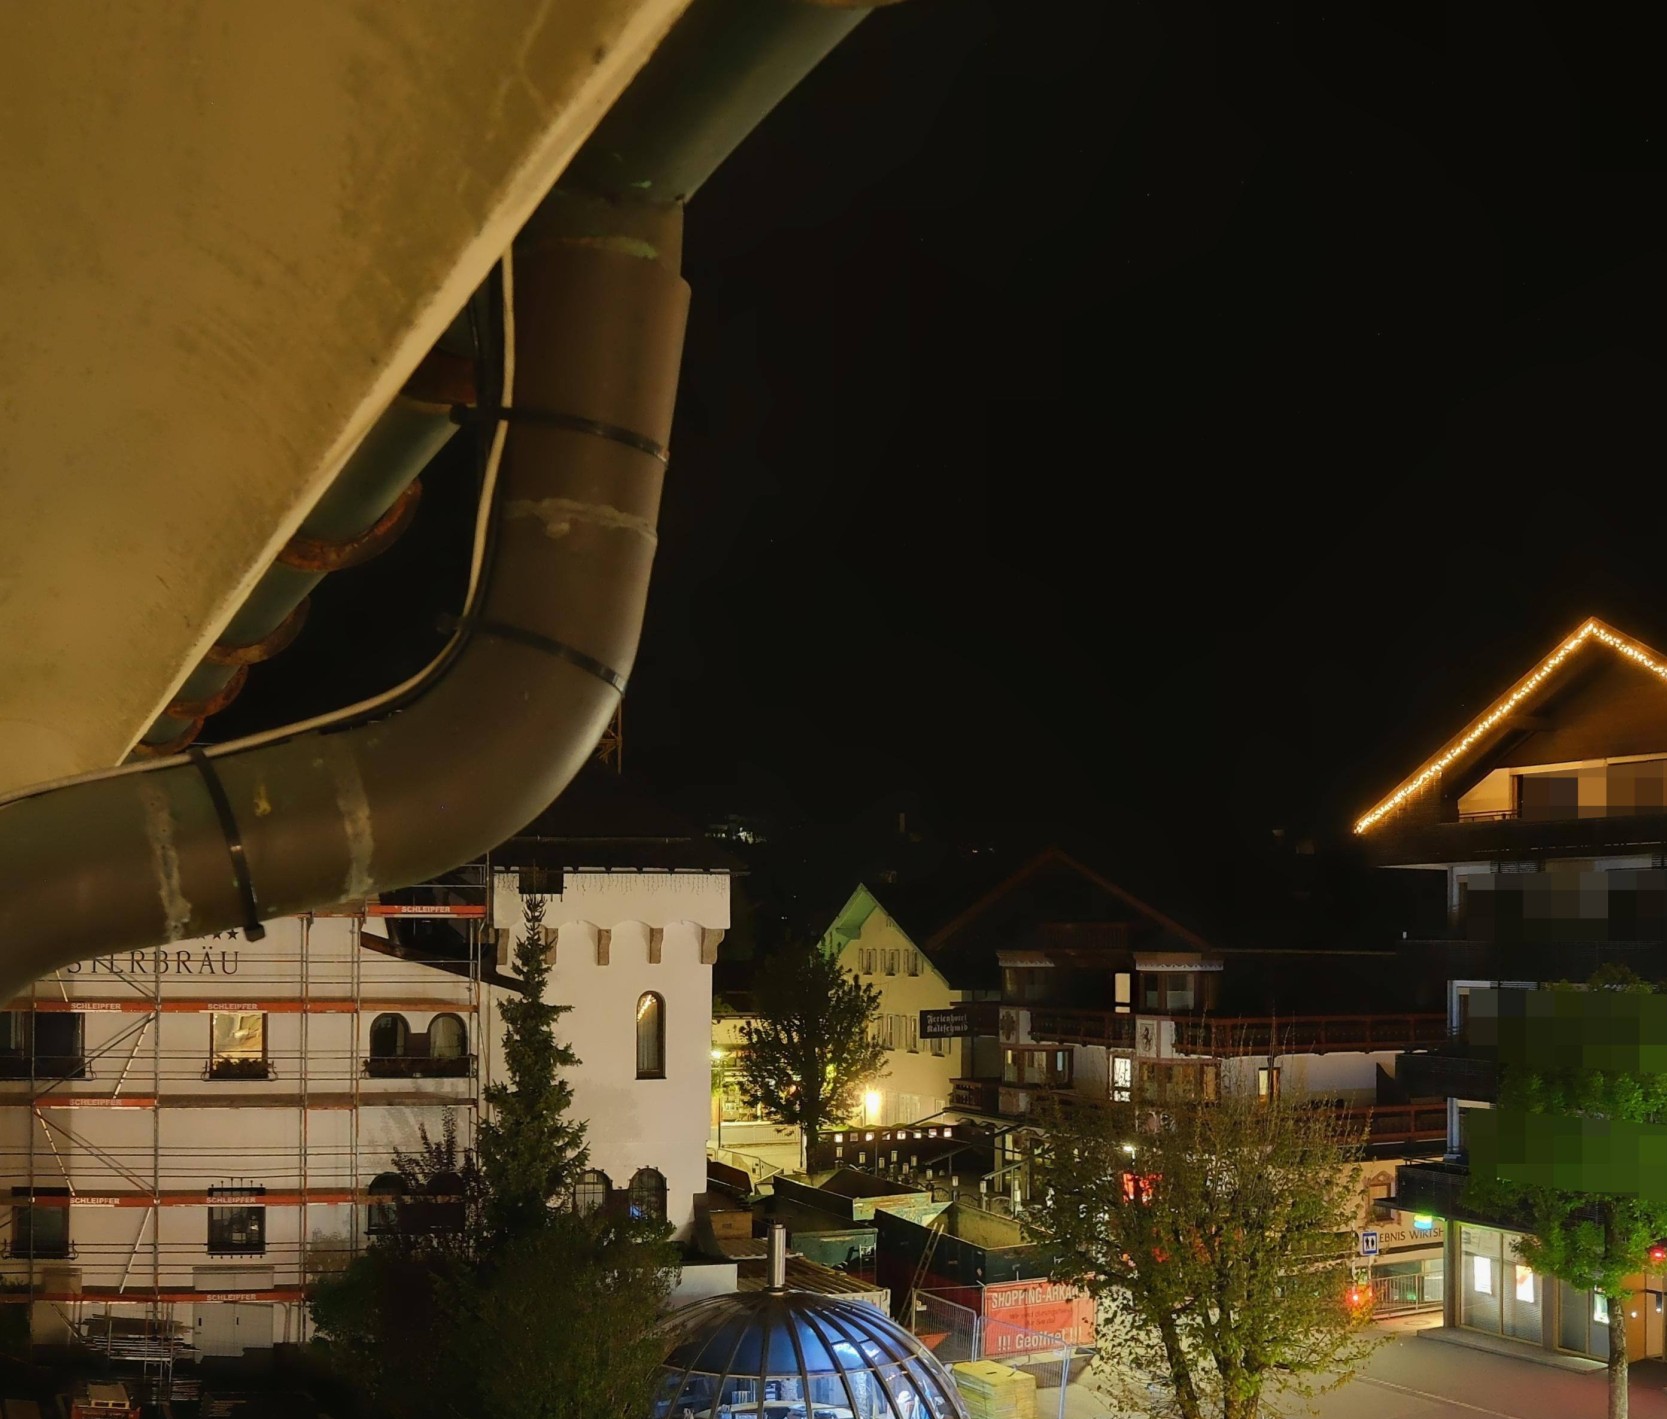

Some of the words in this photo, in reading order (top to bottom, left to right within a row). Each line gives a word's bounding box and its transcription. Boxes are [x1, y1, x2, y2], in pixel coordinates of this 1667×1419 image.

[401, 905, 451, 914] SCHLEIPFER
[71, 1002, 121, 1010] SCHLEIPFER
[208, 1002, 258, 1010] SCHLEIPFER
[70, 1098, 122, 1107] SCHLEIPFER
[70, 1197, 121, 1205] SCHLEIPFER
[206, 1293, 257, 1301] SCHLEIPFER
